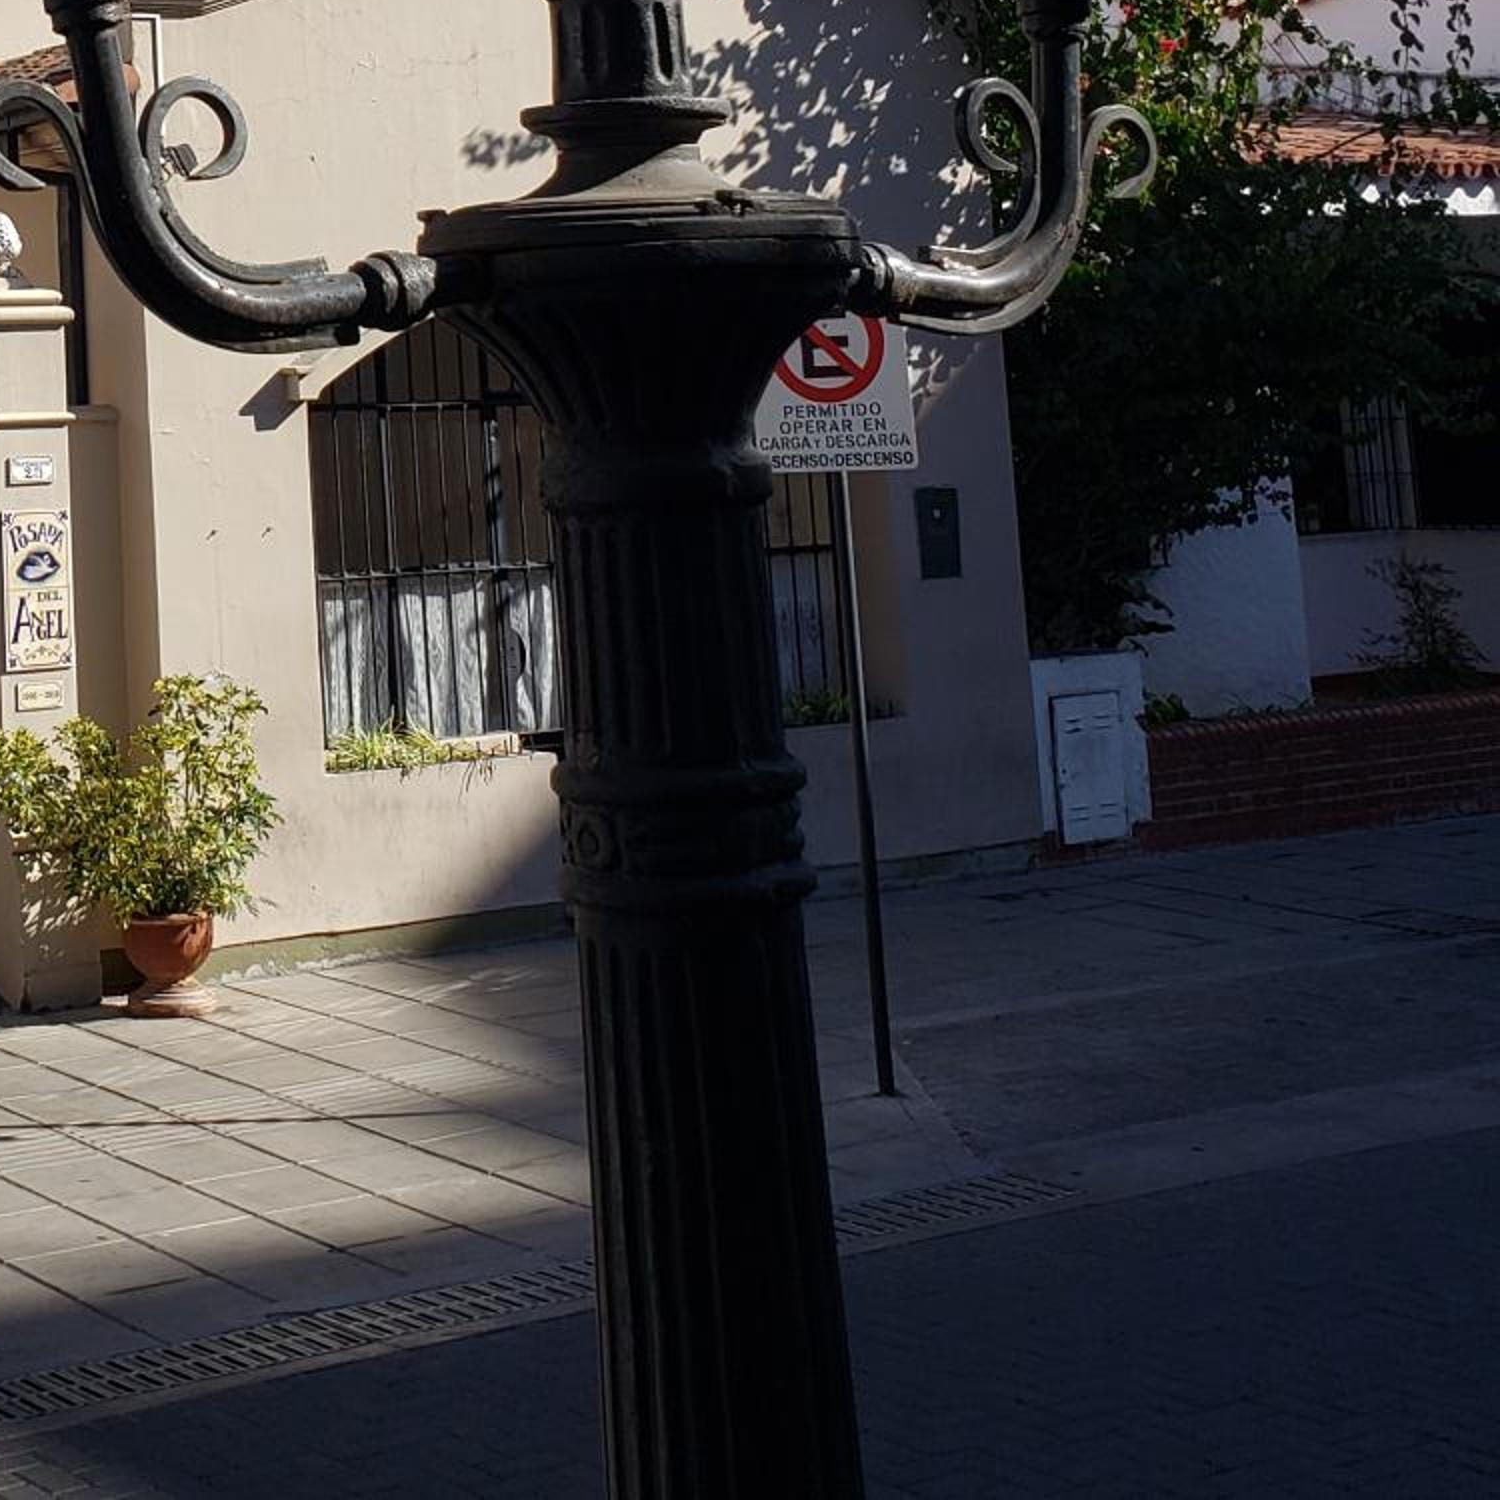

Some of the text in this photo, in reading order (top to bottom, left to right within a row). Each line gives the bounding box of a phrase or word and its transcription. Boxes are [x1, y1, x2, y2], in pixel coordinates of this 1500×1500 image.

[784, 402, 881, 418] PERMITIDO
[780, 418, 887, 434] OPERAR EN
[760, 436, 811, 451] CARGA
[826, 432, 910, 449] DESCARGA
[771, 454, 828, 468] SCENSO
[835, 452, 913, 467] DESCENSO
[9, 522, 63, 553] POSADA
[37, 591, 63, 602] DEL
